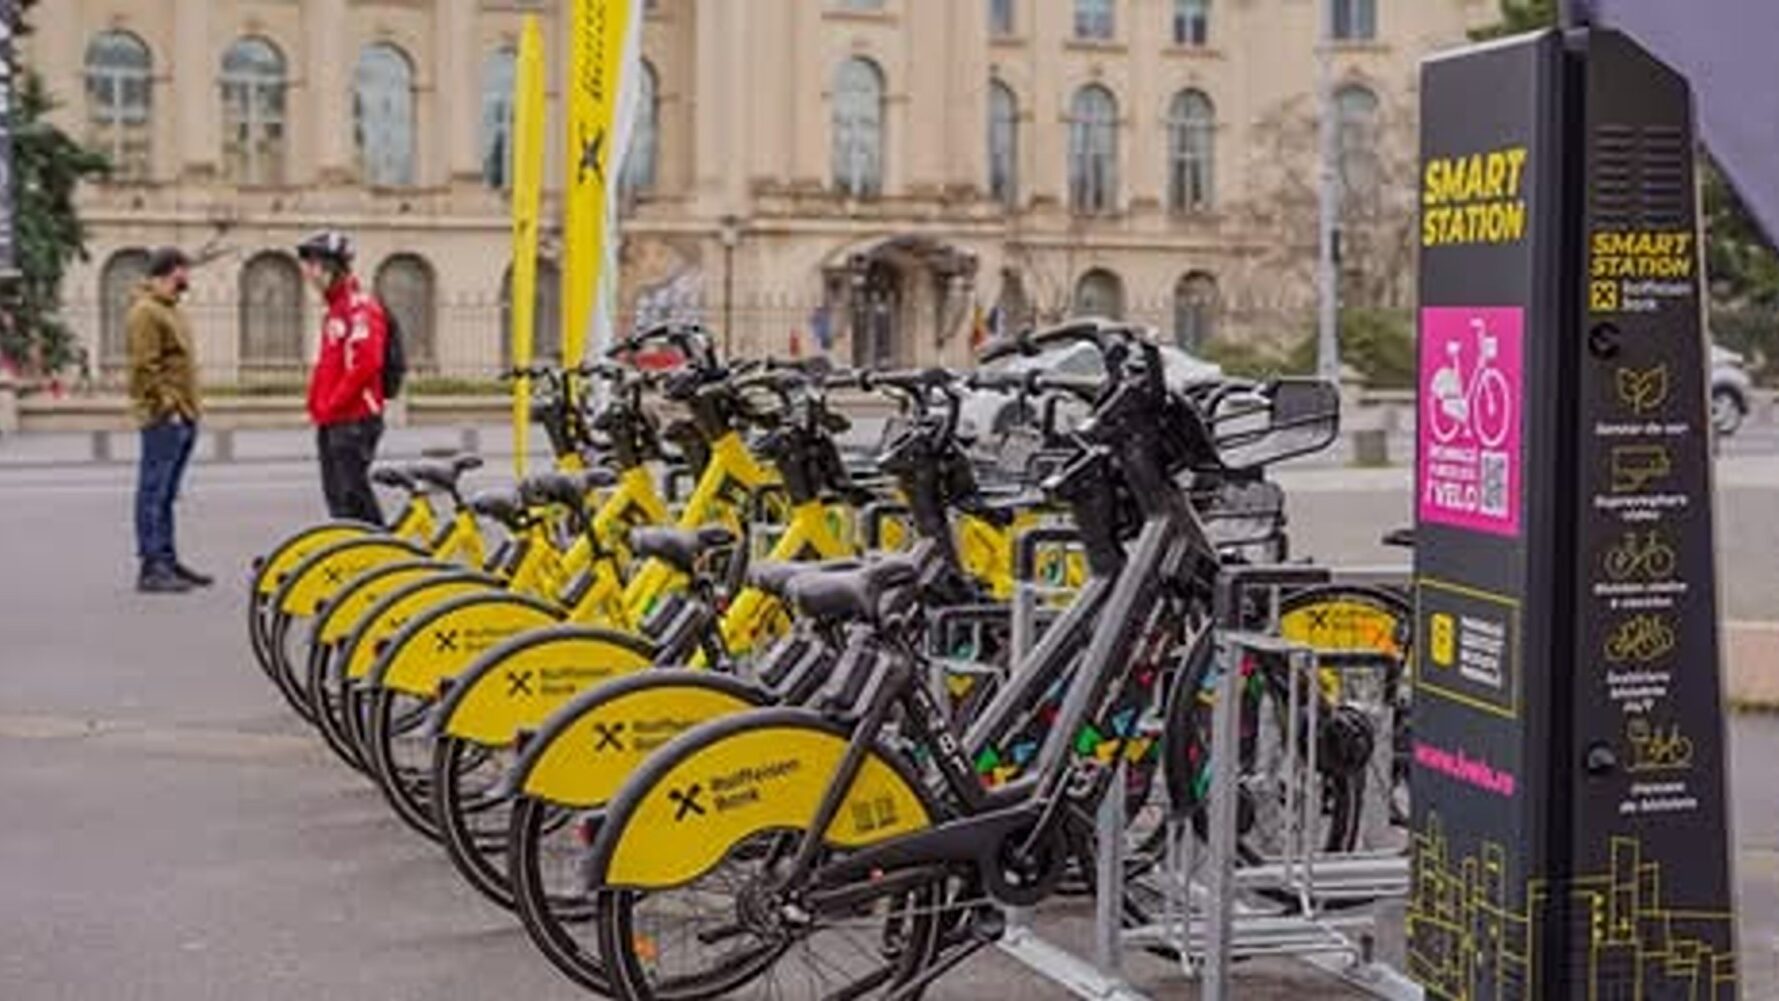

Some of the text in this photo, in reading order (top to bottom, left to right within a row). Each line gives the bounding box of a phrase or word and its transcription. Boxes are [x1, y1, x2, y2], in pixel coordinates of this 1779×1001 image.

[1424, 146, 1527, 204] SMART
[1423, 201, 1525, 246] STATION
[1591, 232, 1693, 255] SMART
[1590, 256, 1691, 277] STATION
